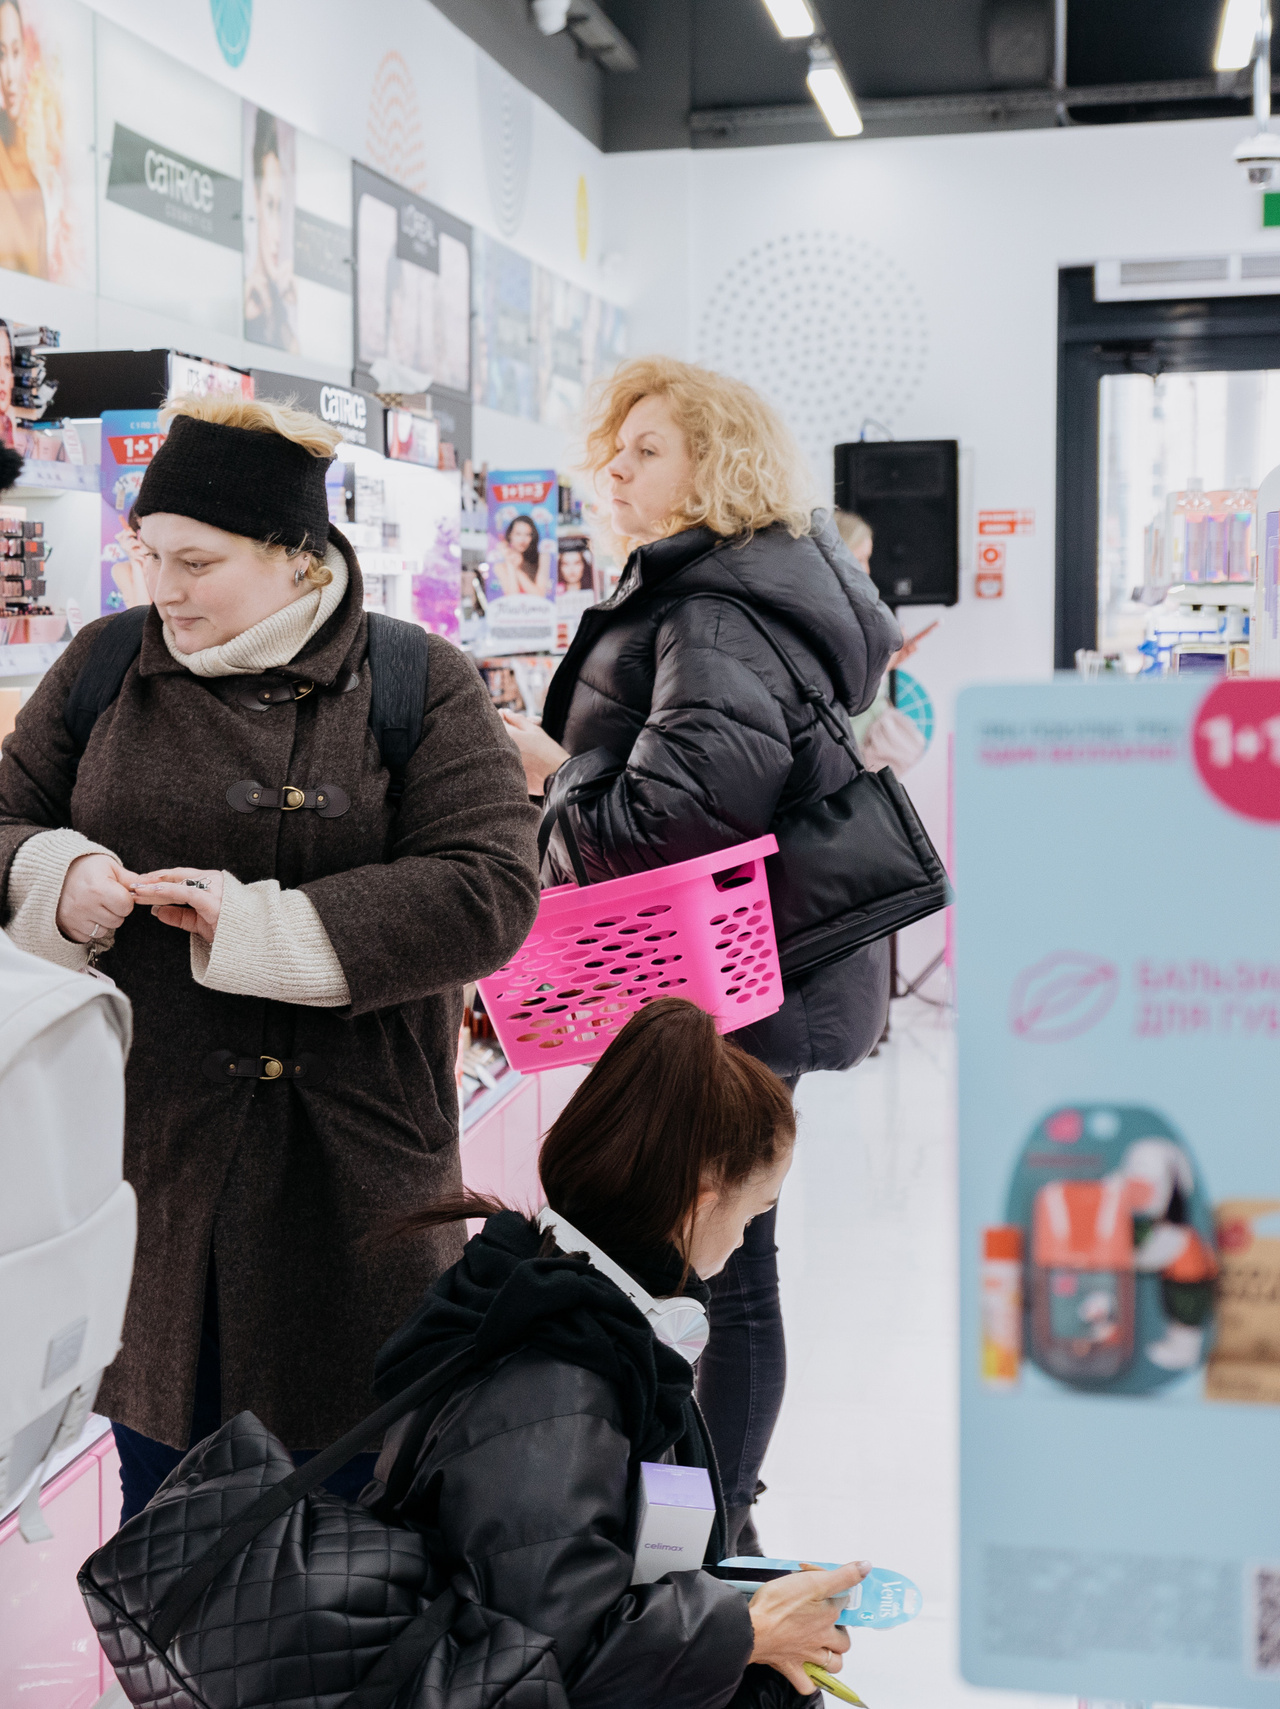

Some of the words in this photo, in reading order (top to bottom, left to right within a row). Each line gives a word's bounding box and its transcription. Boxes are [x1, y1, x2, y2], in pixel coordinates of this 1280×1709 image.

[123, 437, 160, 458] 1+1
[644, 1542, 684, 1552] celimax
[881, 1581, 902, 1618] Venus
